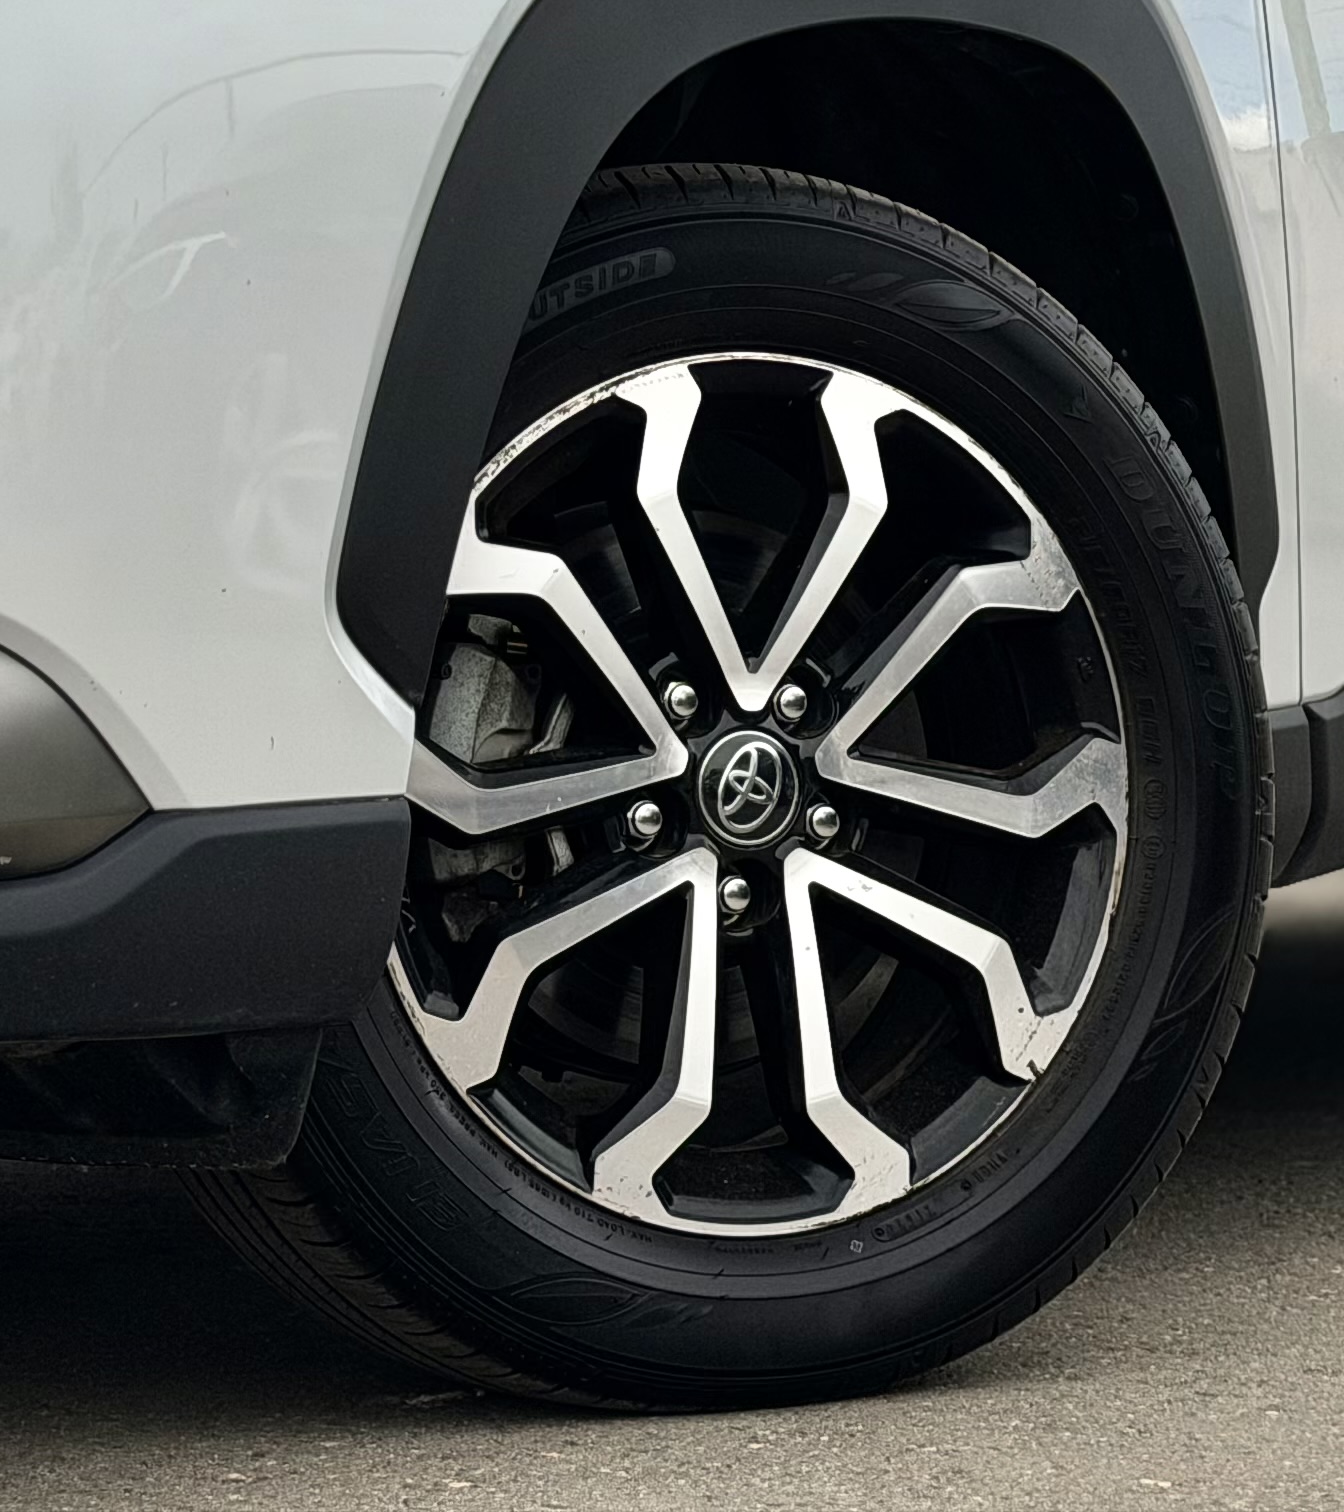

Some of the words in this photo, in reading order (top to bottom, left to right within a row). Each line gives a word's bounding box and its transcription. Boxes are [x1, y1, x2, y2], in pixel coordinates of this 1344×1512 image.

[527, 252, 657, 321] UTSIDE
[1102, 451, 1241, 801] DUNLOP
[596, 1216, 626, 1235] LOAD
